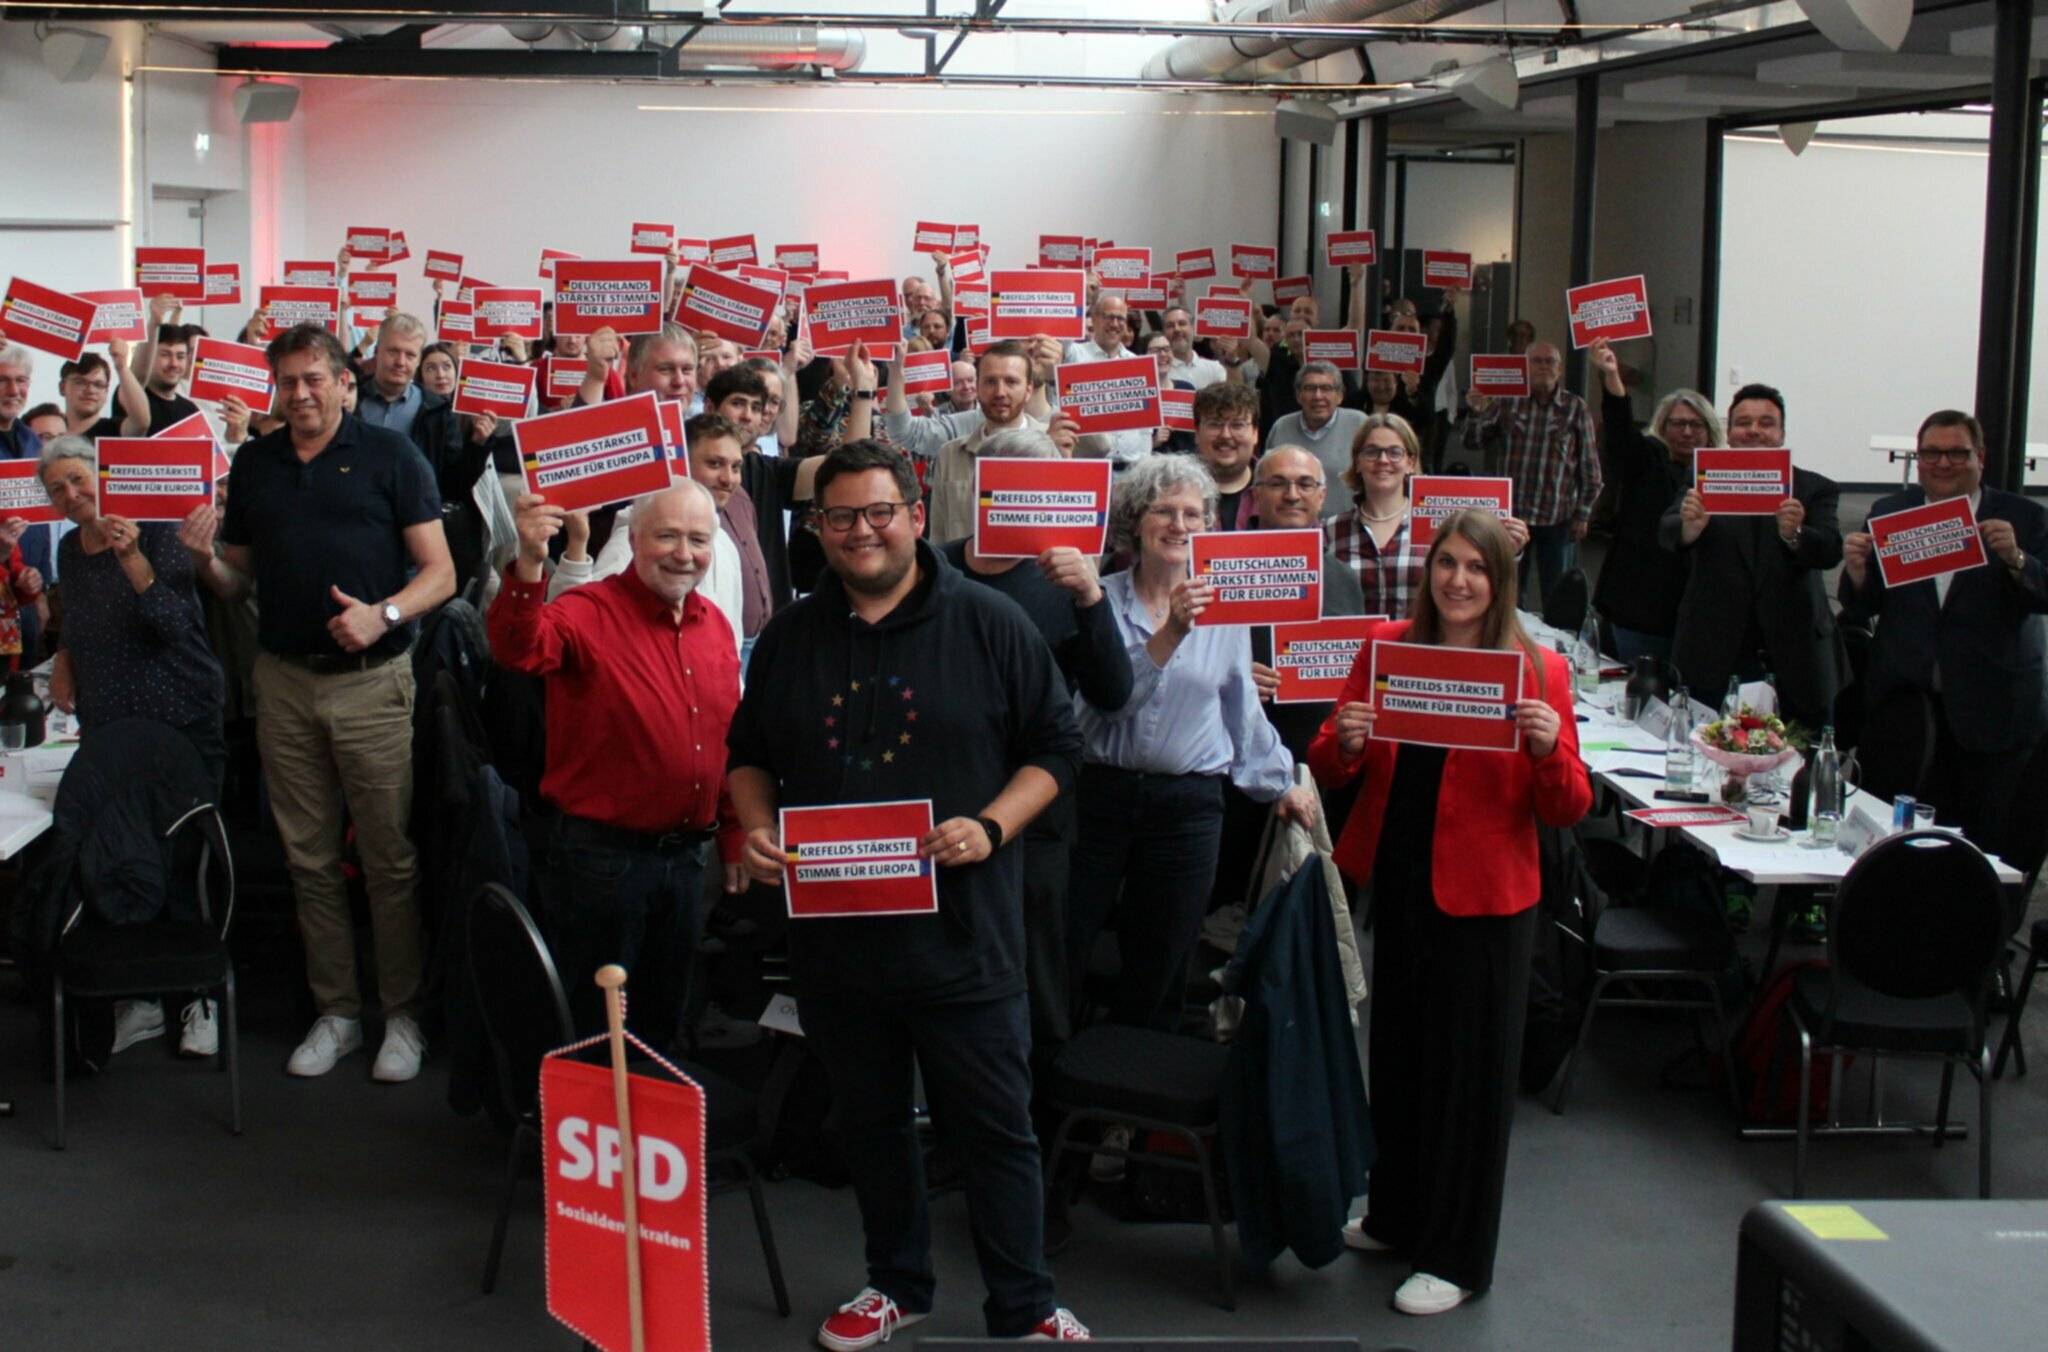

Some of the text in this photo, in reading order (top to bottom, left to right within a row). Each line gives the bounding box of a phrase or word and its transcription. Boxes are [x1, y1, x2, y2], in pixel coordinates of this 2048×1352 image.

[571, 282, 648, 290] DEUTSCHLANDS
[559, 294, 658, 302] STÄRKSTE STIMMEN
[1001, 293, 1071, 301] KREFELDS STÄRKSTE
[579, 306, 642, 314] FÜR EUROPA
[821, 298, 886, 310] DEUTSCHLANDS
[811, 308, 896, 321] STÄRKSTE STIMMEN
[1028, 307, 1042, 315] FÜR
[829, 319, 883, 329] FÜR EUROPA
[1072, 378, 1145, 393] DEUTSCHLANDS
[1062, 389, 1156, 405] STÄRKSTE STIMMEN
[1081, 401, 1142, 414] FÜR EUROPA
[538, 444, 590, 463] KREFELDS
[591, 431, 643, 452] STÄRKSTE
[111, 467, 197, 476] KREFELDS STÄRKSTE
[538, 451, 650, 484] STIMME FÜR EUROPA
[1707, 471, 1778, 480] KREFELDS STÄRKSTE
[107, 483, 201, 492] STIMME FÜR EUROPA
[1704, 484, 1733, 492] STIMME
[1734, 484, 1748, 492] FÜR
[994, 494, 1092, 504] KREFELDS STÄRKSTE
[1426, 498, 1497, 506] DEUTSCHLANDS
[989, 513, 1094, 523] STIMME FÜR EUROPA
[1890, 520, 1961, 543] DEUTSCHLANDS
[1881, 528, 1973, 555] STÄRKSTE STIMMEN
[1902, 543, 1961, 562] FÜR EUROPA
[1213, 558, 1305, 571] DEUTSCHLANDS
[1201, 572, 1316, 586] TÄRKSTE STIMMEN
[1222, 588, 1297, 600] FÜR EUROPA
[1291, 641, 1363, 651] DEUTSCHLAN
[1279, 652, 1356, 665] STÄRKSTE STIM
[1300, 667, 1351, 677] FÜR EURO
[1390, 678, 1499, 696] KREFELDS STÄRKSTE
[1385, 697, 1501, 715] STIMME FÜR EUROPA
[800, 840, 912, 857] KREFELDS STÄRKSTE
[798, 863, 916, 879] STIMME FÜR EUROPA
[557, 1116, 688, 1202] SPD
[556, 1200, 691, 1250] Sozialdemkraten
